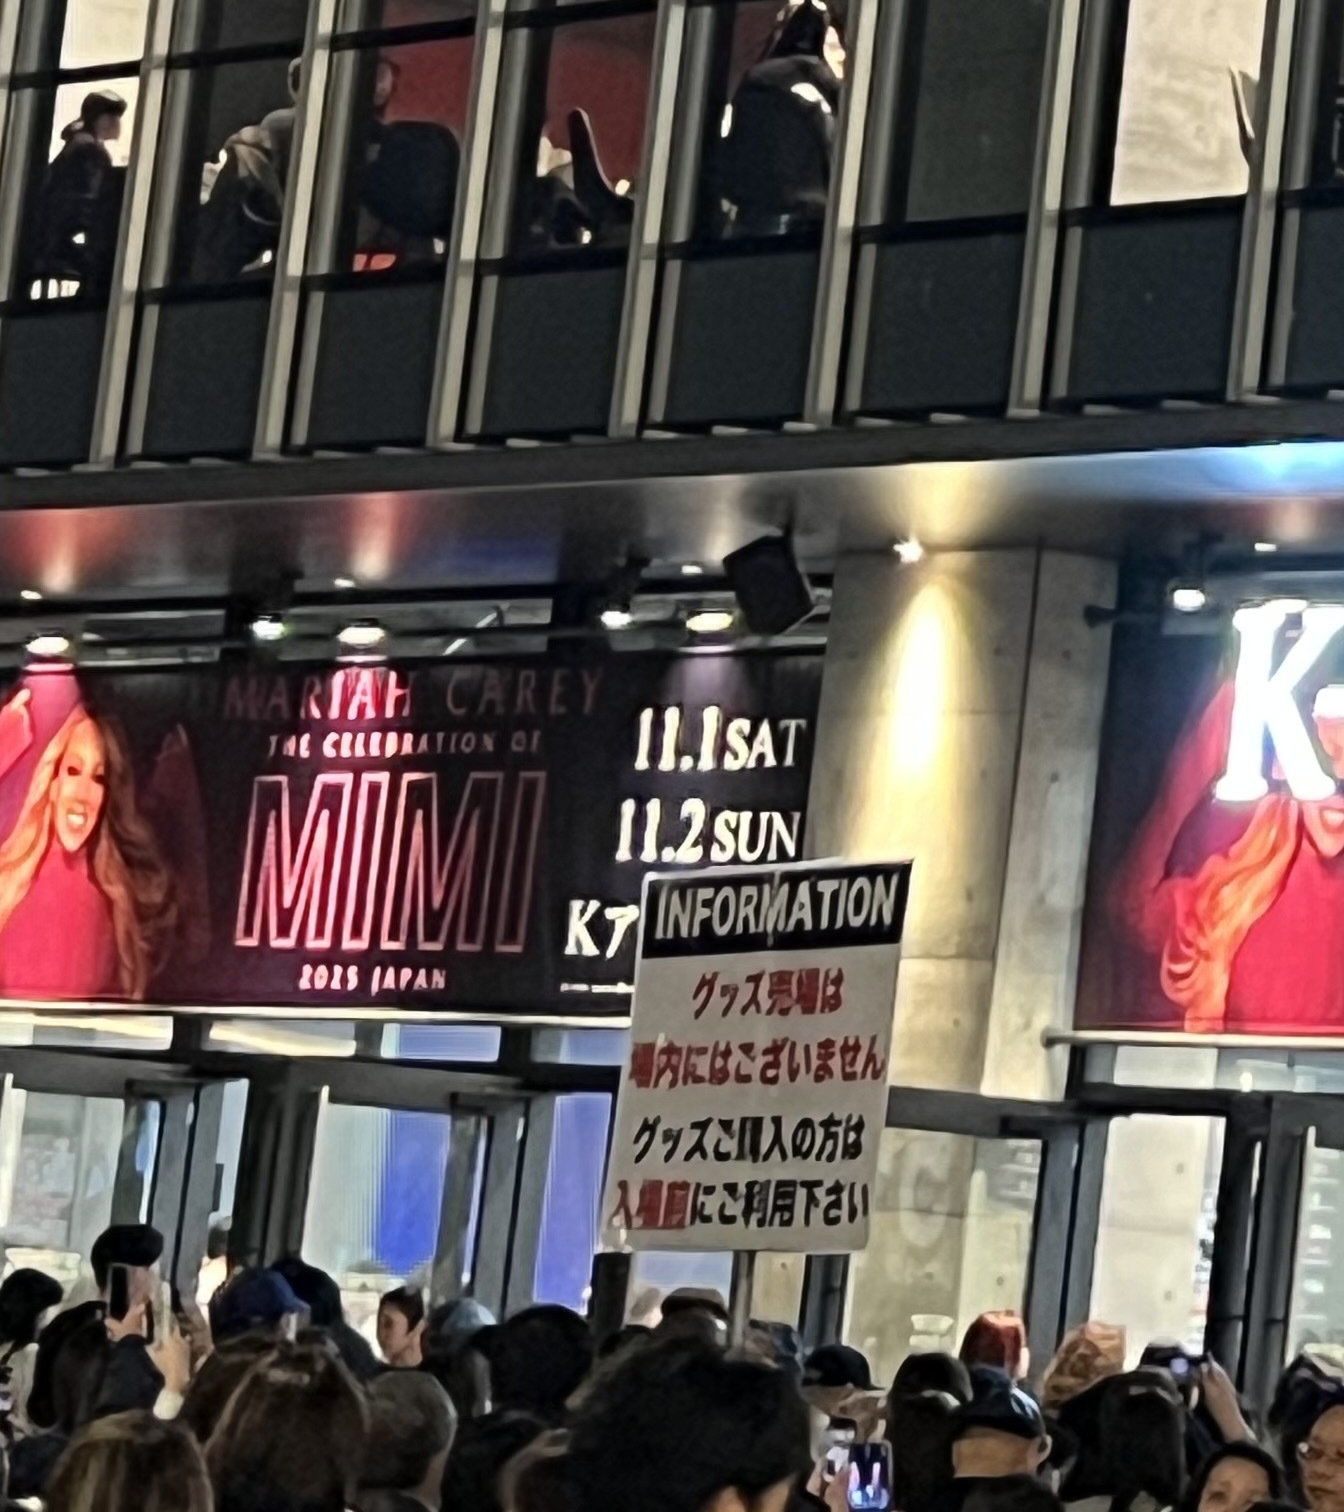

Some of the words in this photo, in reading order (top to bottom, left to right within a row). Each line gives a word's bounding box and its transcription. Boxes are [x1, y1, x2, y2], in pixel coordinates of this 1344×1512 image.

[446, 668, 602, 718] CAREY
[234, 771, 548, 953] MIMI
[654, 873, 899, 940] INFORMATION
[299, 963, 359, 991] 2025
[371, 965, 447, 997] JAPAN
